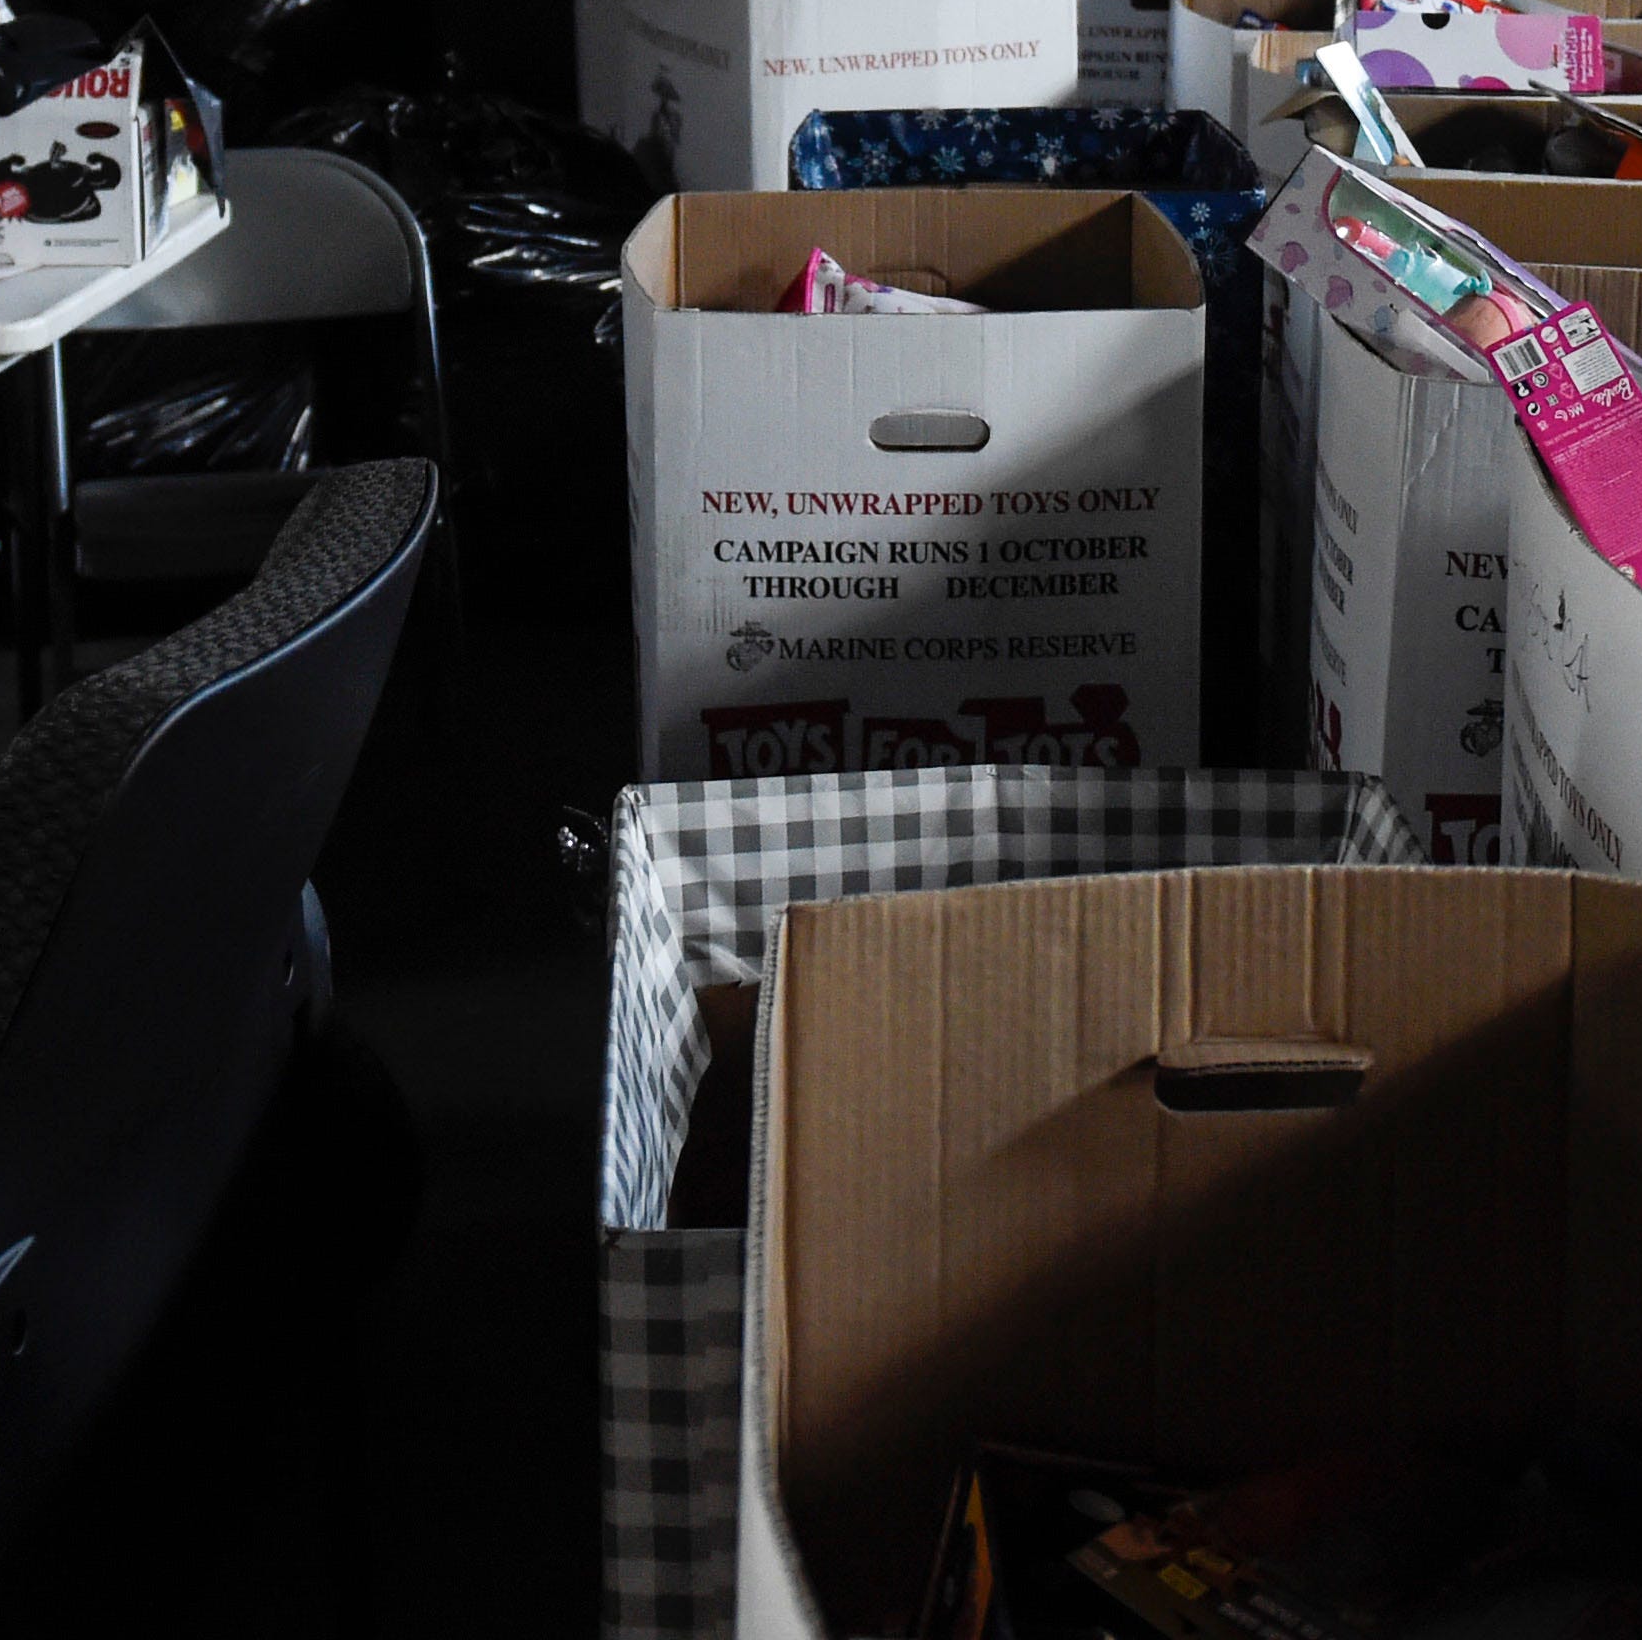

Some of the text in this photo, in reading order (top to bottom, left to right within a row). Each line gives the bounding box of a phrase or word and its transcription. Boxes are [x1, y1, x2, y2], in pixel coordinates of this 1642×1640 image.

[763, 39, 1042, 81] NEW, UNWRAPPED TOYS ONLY
[702, 487, 1161, 519] NEW, UNWRAPPED TOYS ONLY
[713, 535, 1149, 564] CAMPAIGN RUNS 1 OCTOBER
[743, 572, 1120, 600] THROUGH DECEMBER
[778, 633, 1137, 662] MARINE CORPS RESERVE
[716, 717, 836, 777] TOYS
[1558, 765, 1586, 828] TOYS
[1587, 807, 1622, 871] ONLY
